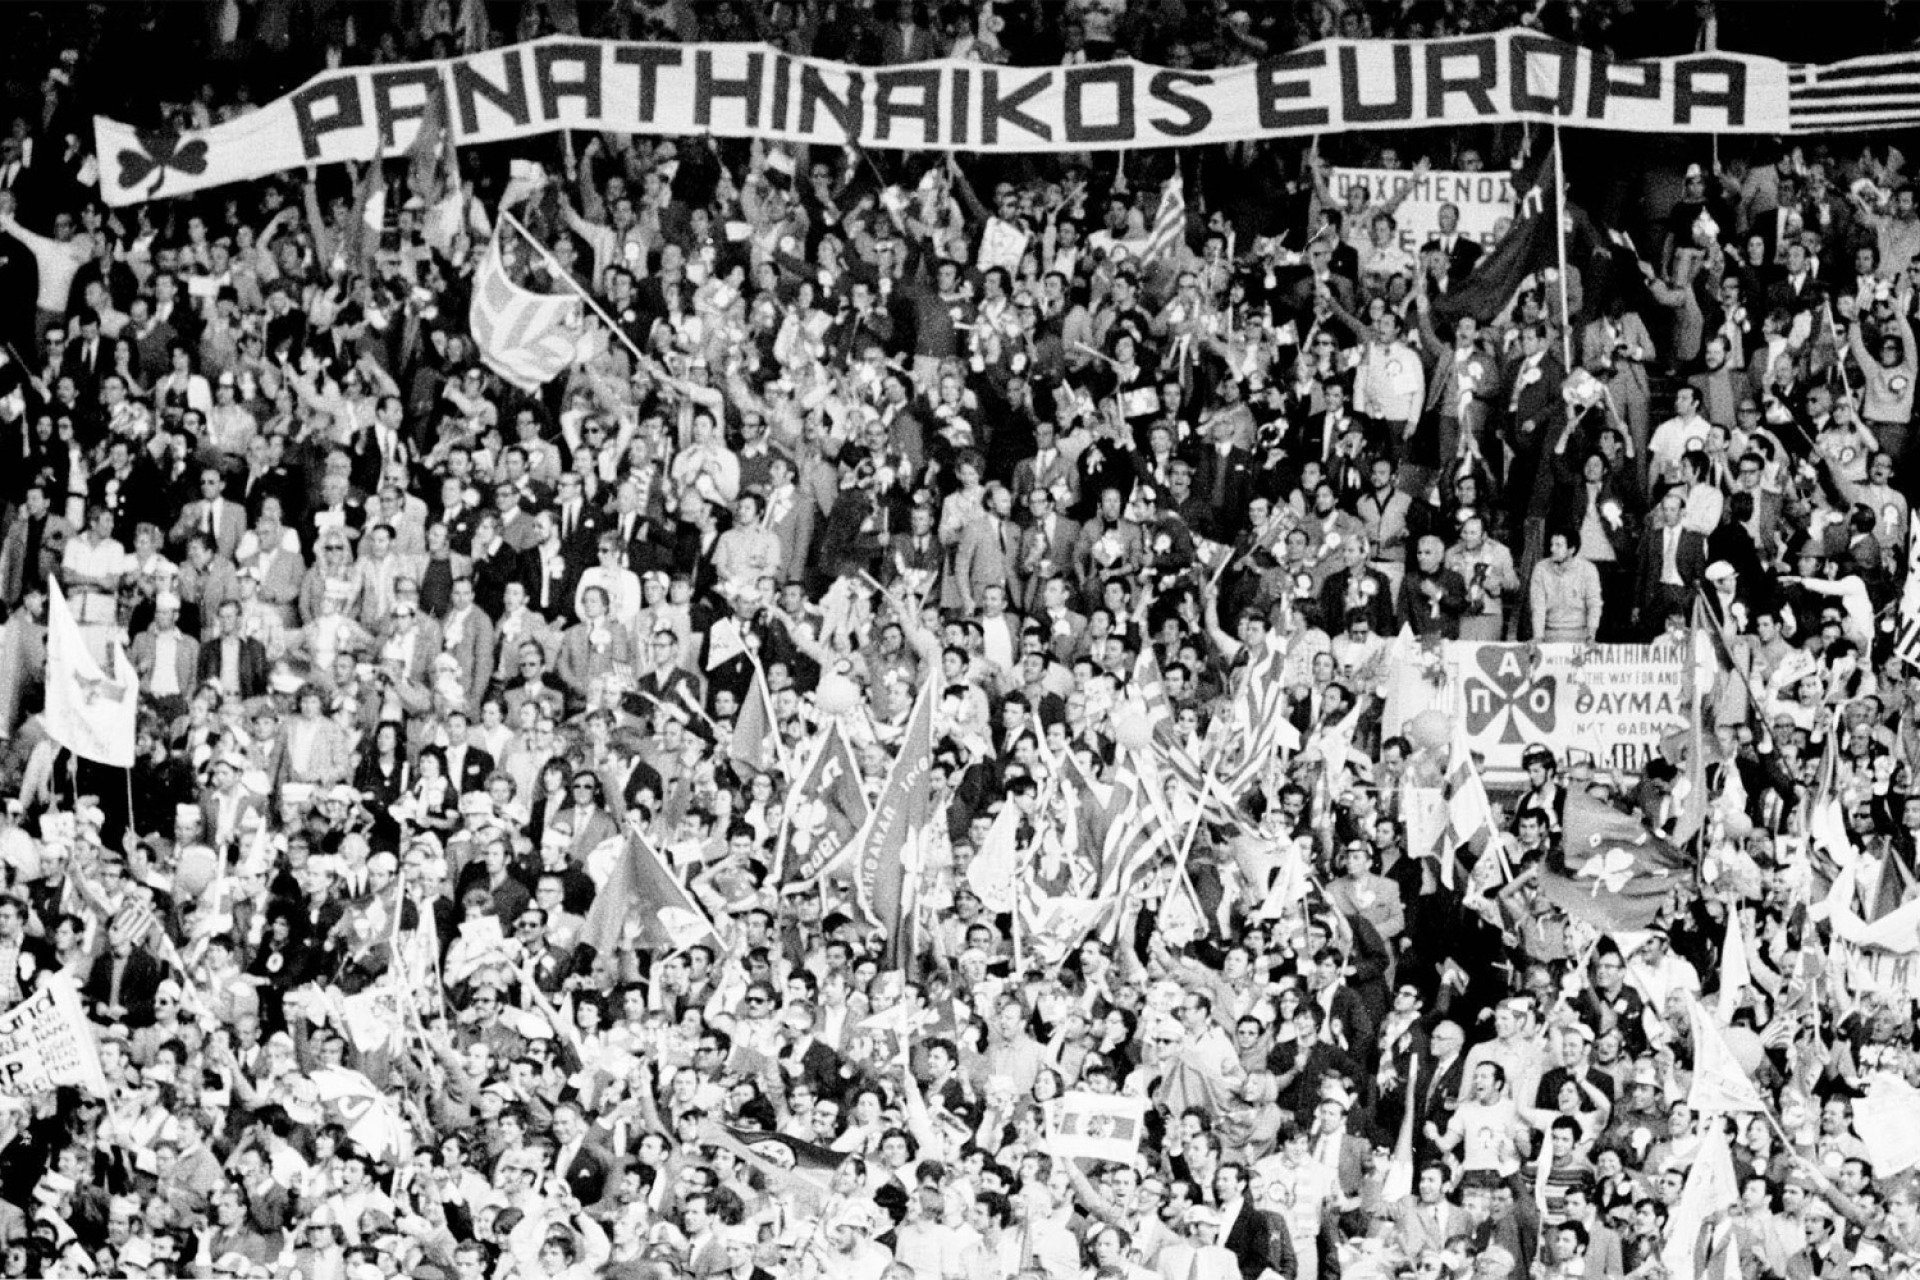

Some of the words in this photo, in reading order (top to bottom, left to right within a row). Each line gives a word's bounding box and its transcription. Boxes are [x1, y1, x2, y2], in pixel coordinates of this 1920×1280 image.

[291, 43, 1213, 158] PANATHINAIKOS
[1256, 34, 1746, 129] EUROPA
[1609, 671, 1632, 684] WAY
